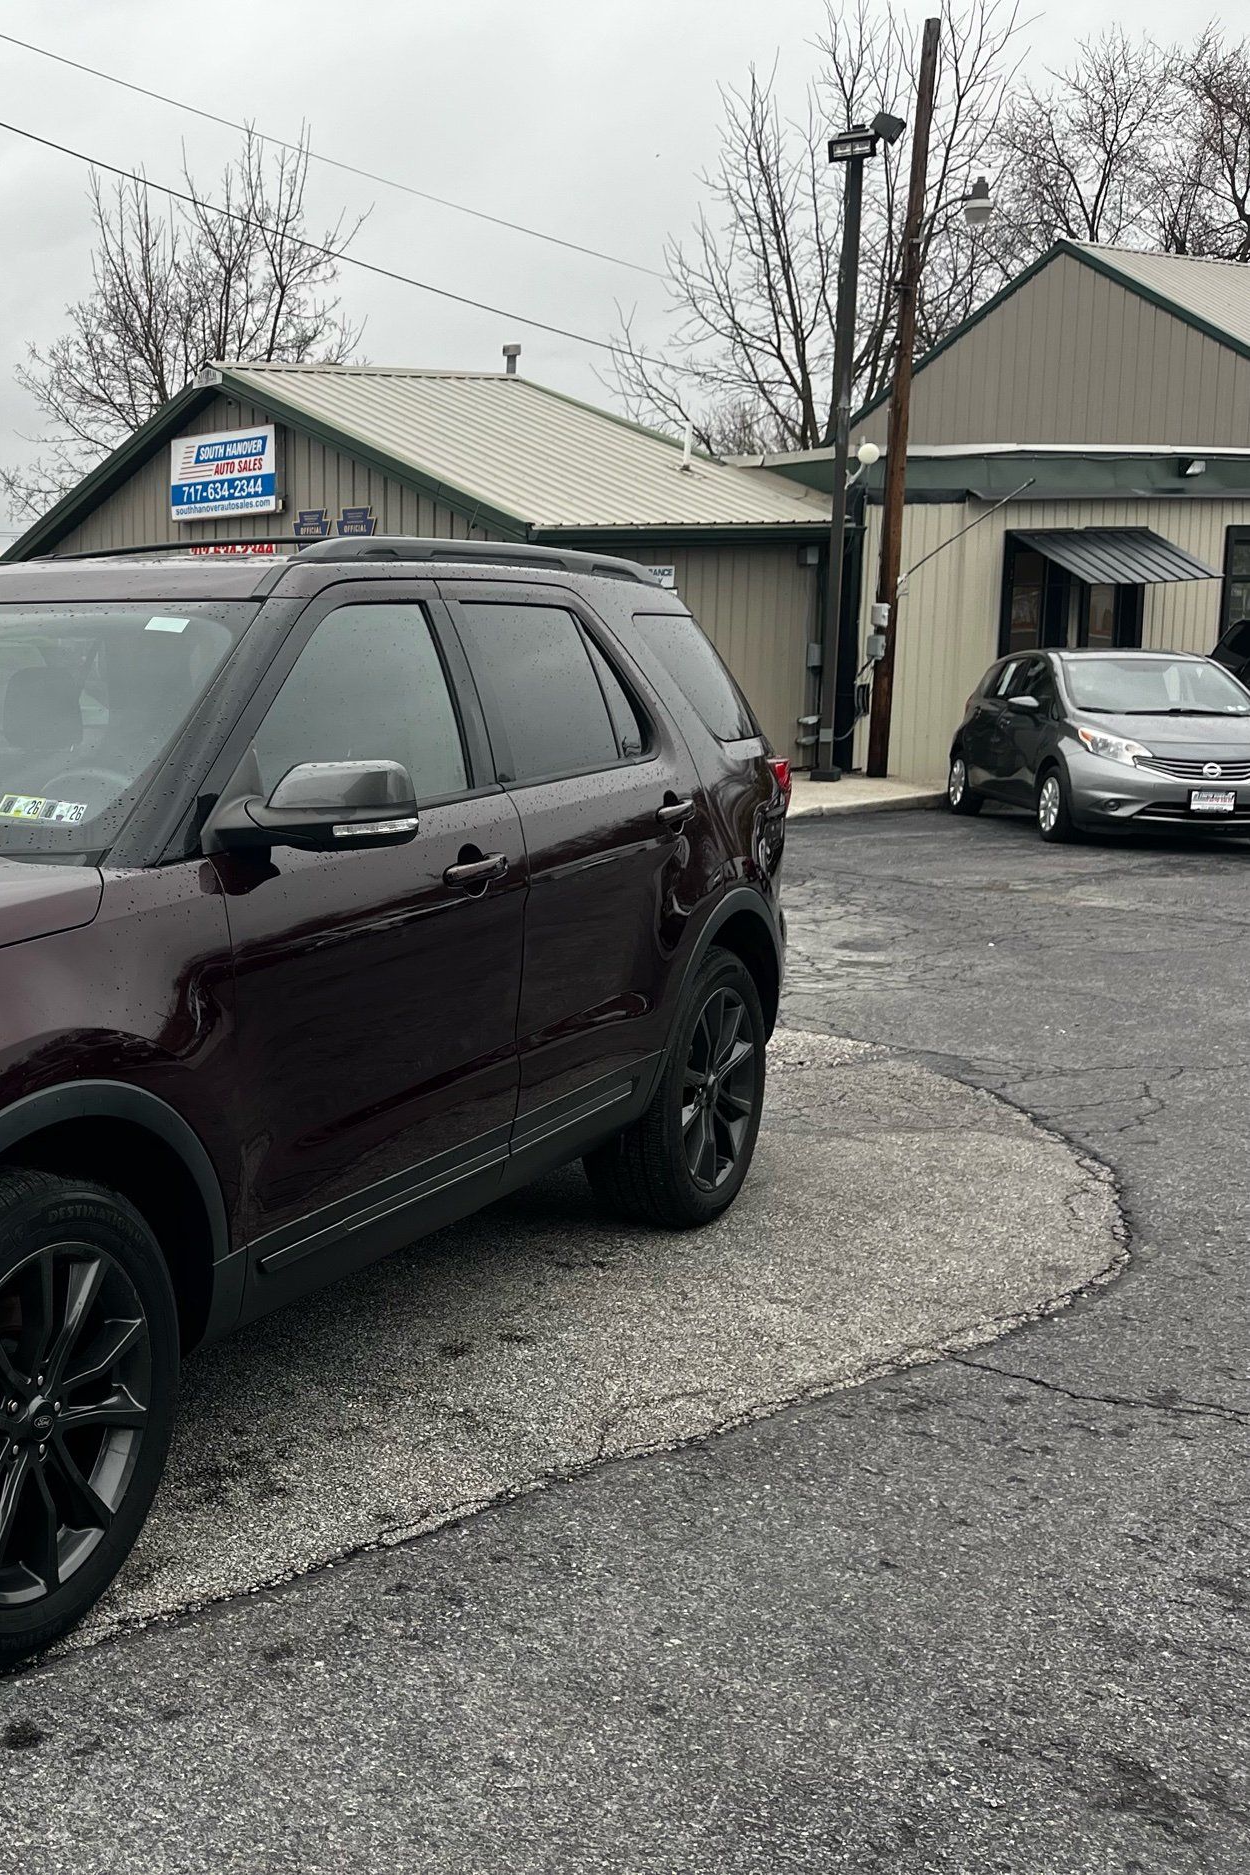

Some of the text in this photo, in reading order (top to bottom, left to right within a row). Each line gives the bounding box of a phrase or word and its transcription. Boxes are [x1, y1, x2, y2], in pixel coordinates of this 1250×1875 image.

[199, 440, 263, 461] SOUTH HANOVER
[214, 457, 263, 476] AUTO SALES
[183, 478, 262, 502] 717-634-2344
[176, 499, 271, 516] southhanoverautosales.com
[301, 525, 322, 535] OFFICIAL
[344, 524, 366, 533] OFFICIAL
[27, 800, 42, 814] 26
[70, 805, 84, 820] 26
[47, 1205, 135, 1239] DESTINATION
